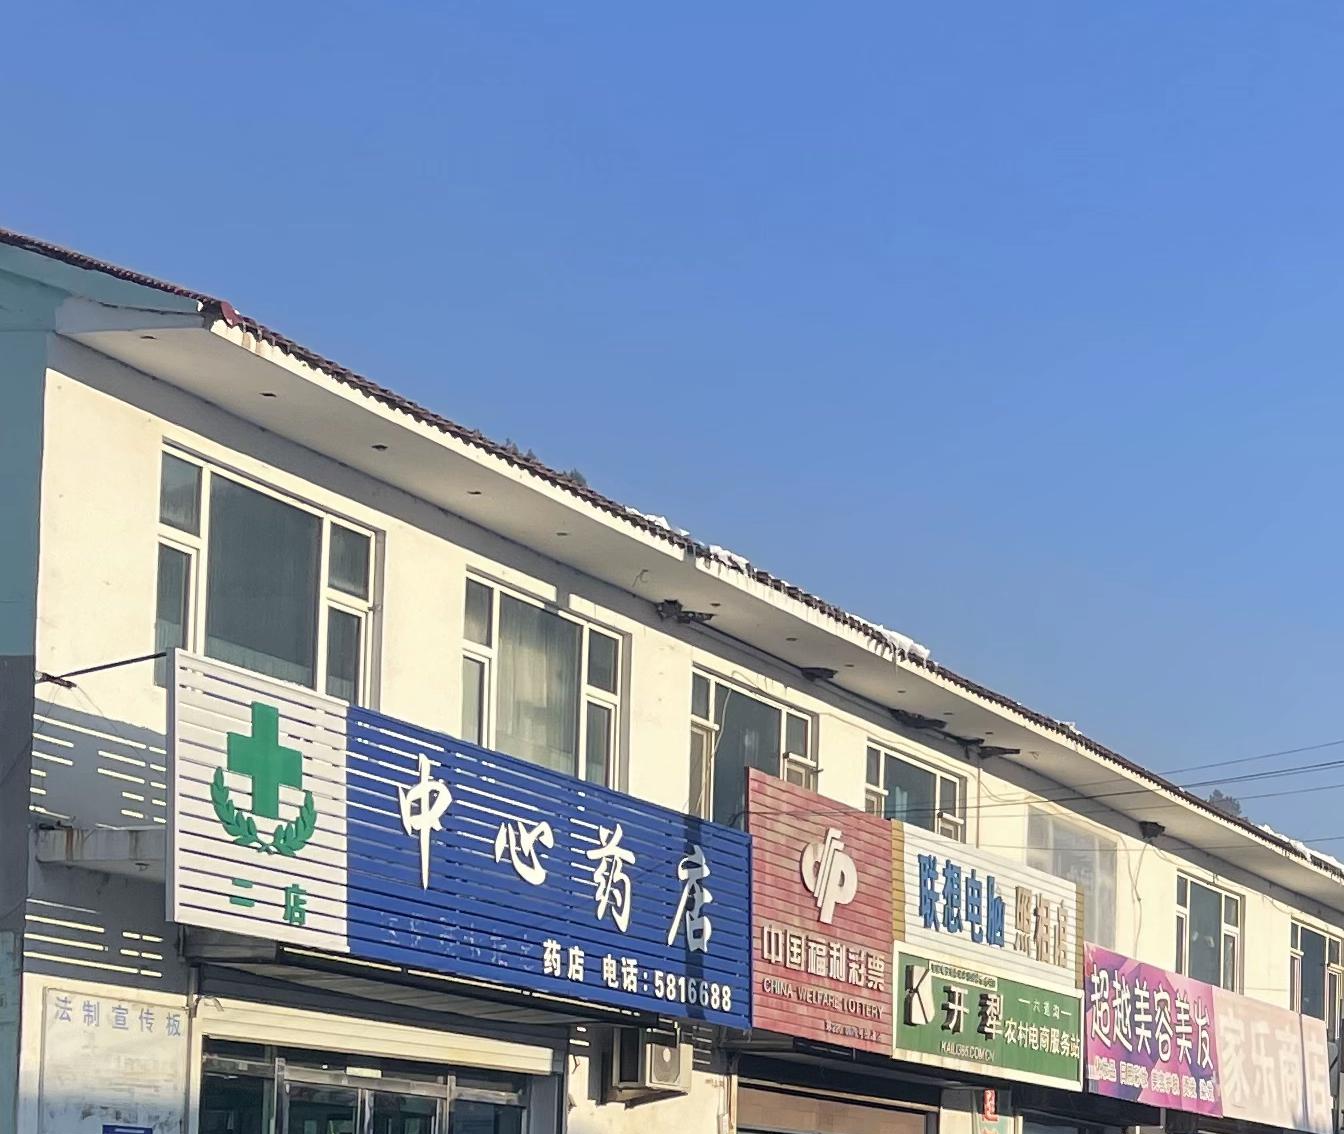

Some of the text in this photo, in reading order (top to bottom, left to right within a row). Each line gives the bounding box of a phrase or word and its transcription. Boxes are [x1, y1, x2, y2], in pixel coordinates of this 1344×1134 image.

[399, 753, 713, 955] 中心药店
[229, 876, 309, 927] 二店
[542, 938, 585, 983] 药店
[762, 925, 885, 992] 中国福利彩票
[54, 995, 182, 1037] 法制宣传板
[762, 977, 884, 1019] CHINA WELFARE LOTTERY
[1090, 962, 1215, 1071] 超越美容美发
[1004, 1018, 1081, 1060] 农村电商服务站
